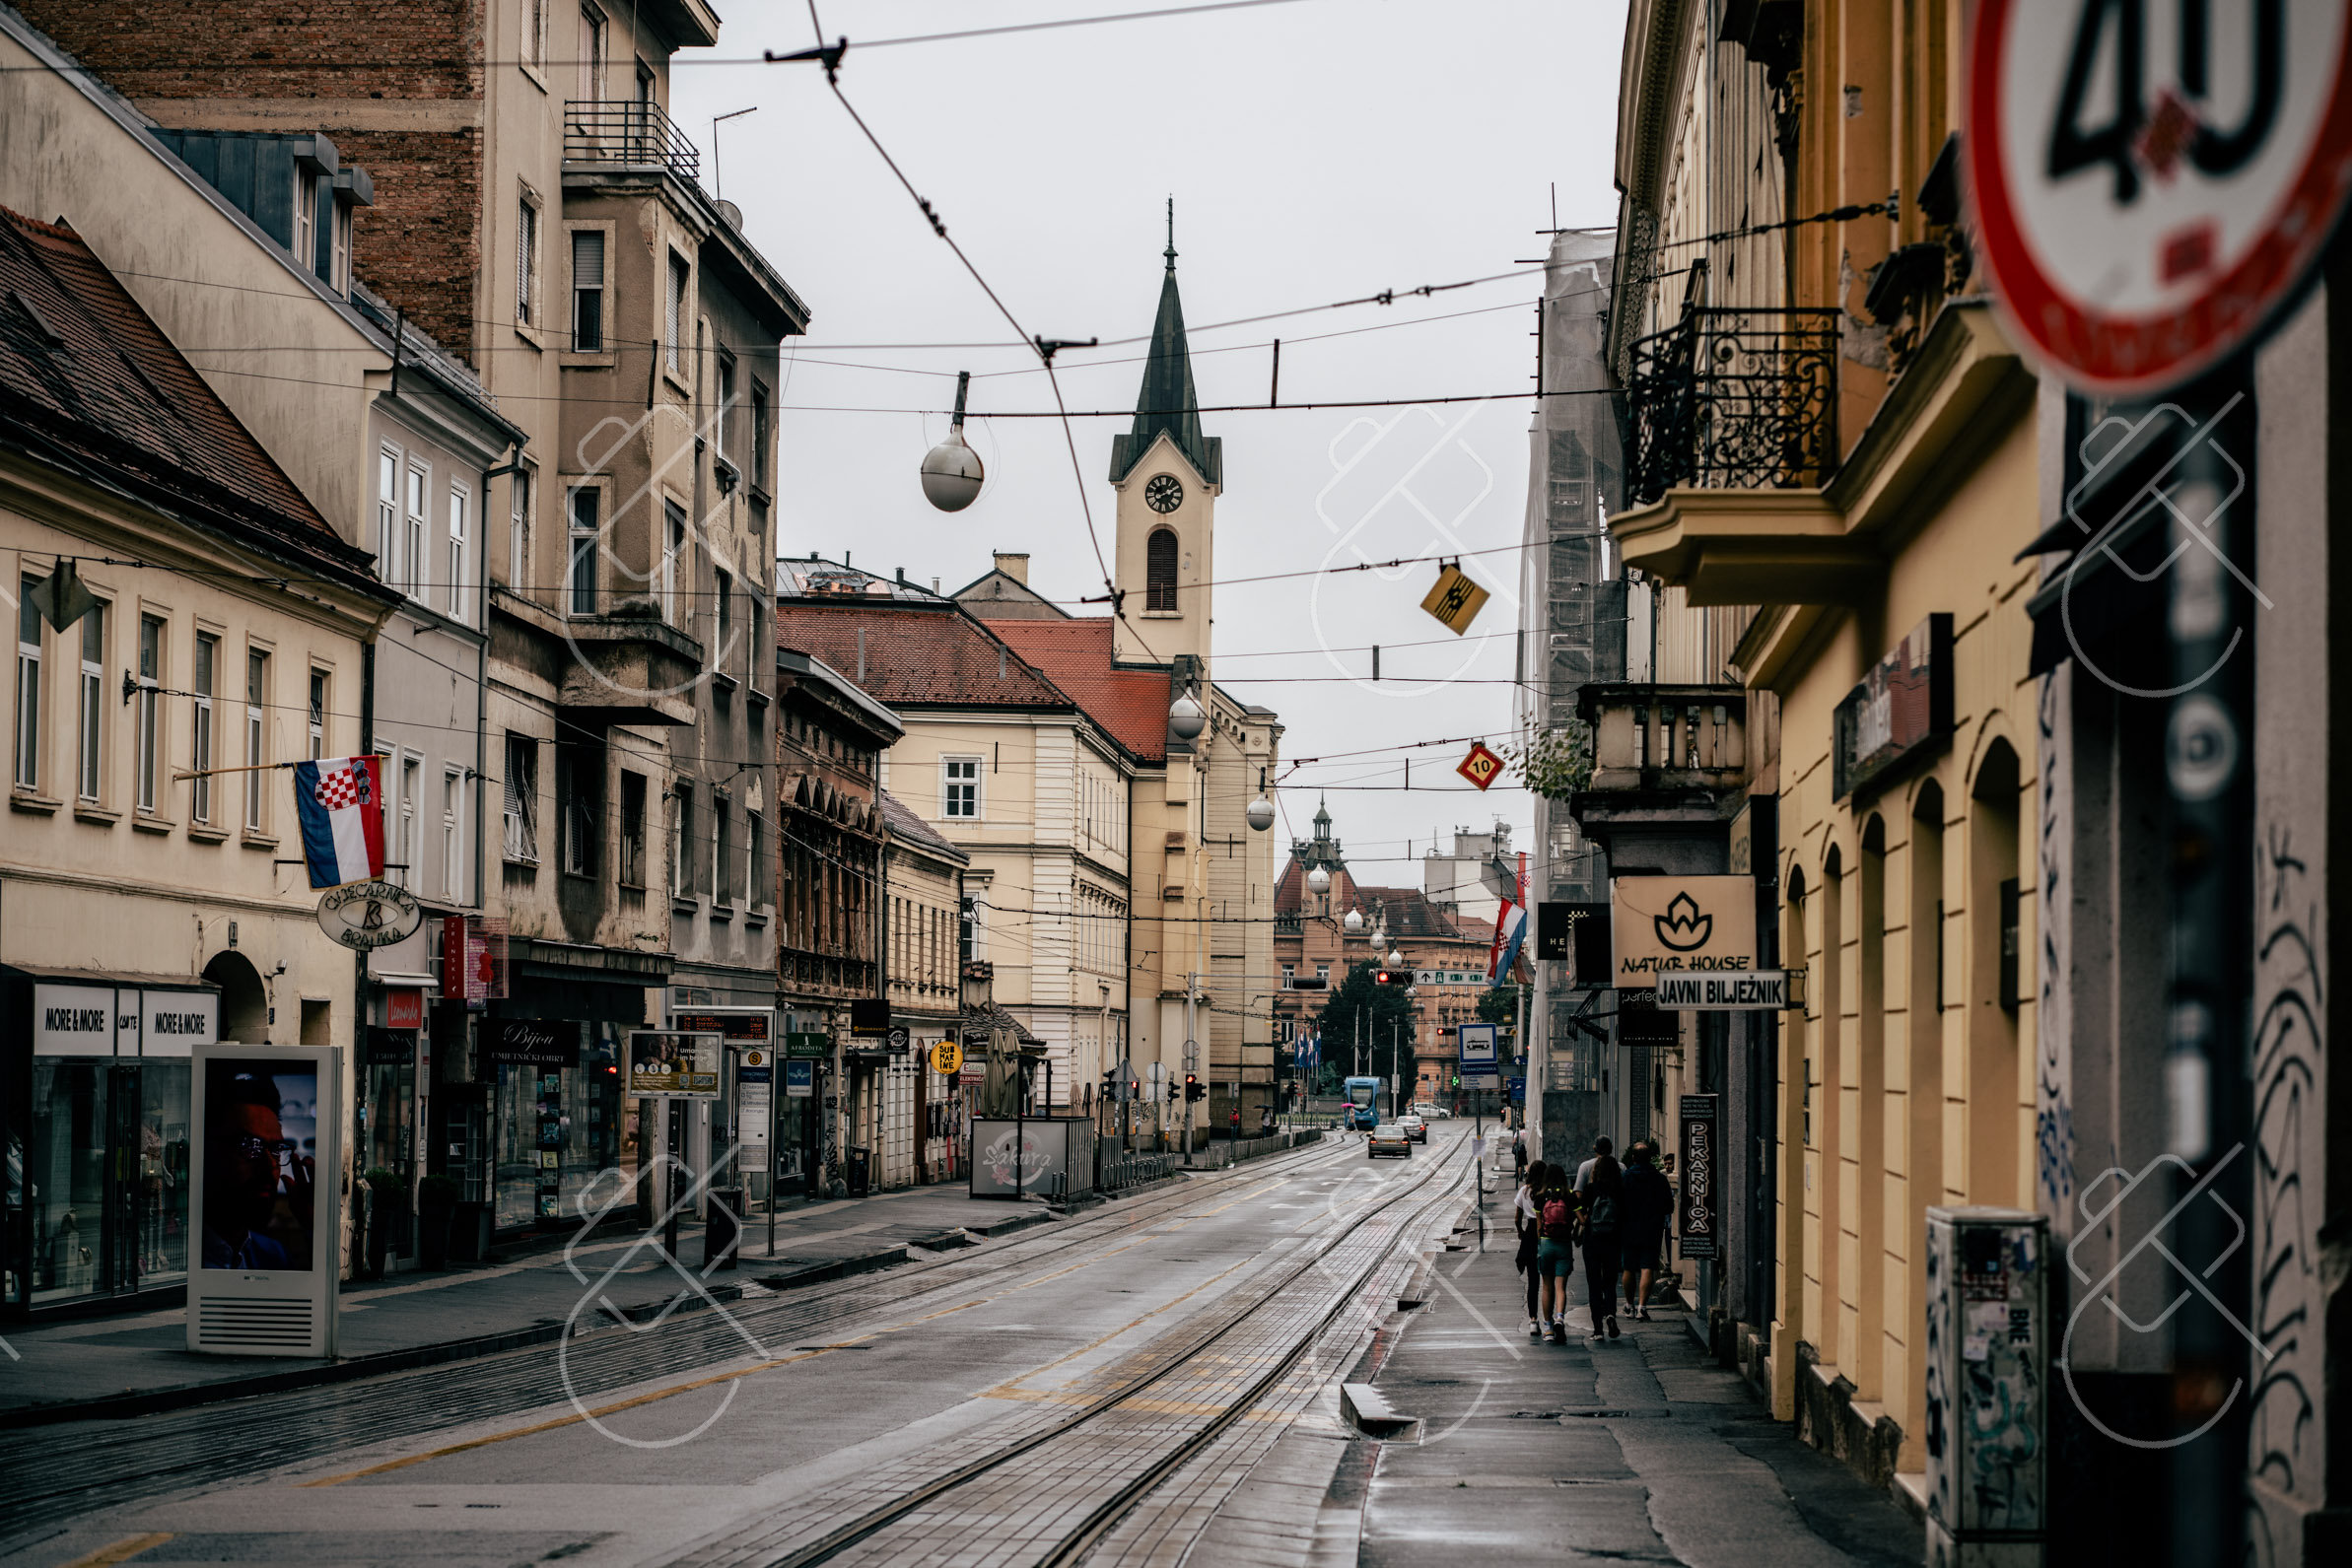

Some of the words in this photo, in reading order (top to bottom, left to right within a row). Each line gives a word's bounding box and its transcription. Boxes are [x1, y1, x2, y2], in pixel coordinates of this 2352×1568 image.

[2045, 0, 2287, 207] 40
[1472, 759, 1490, 774] 10
[1621, 956, 1685, 974] NATUR
[1689, 956, 1751, 970] HOUSE
[1659, 980, 1701, 1004] JAVNI
[1706, 975, 1783, 1004] BILJEŽNIK
[45, 1007, 71, 1031] MORE
[73, 1009, 79, 1032] &
[80, 1009, 104, 1032] MORE
[155, 1012, 176, 1034] MORE
[177, 1013, 183, 1035] &
[183, 1013, 205, 1035] MORE
[503, 1024, 554, 1052] Bijou
[982, 1145, 1054, 1167] Sakura
[1689, 1123, 1707, 1231] PEKARNICA
